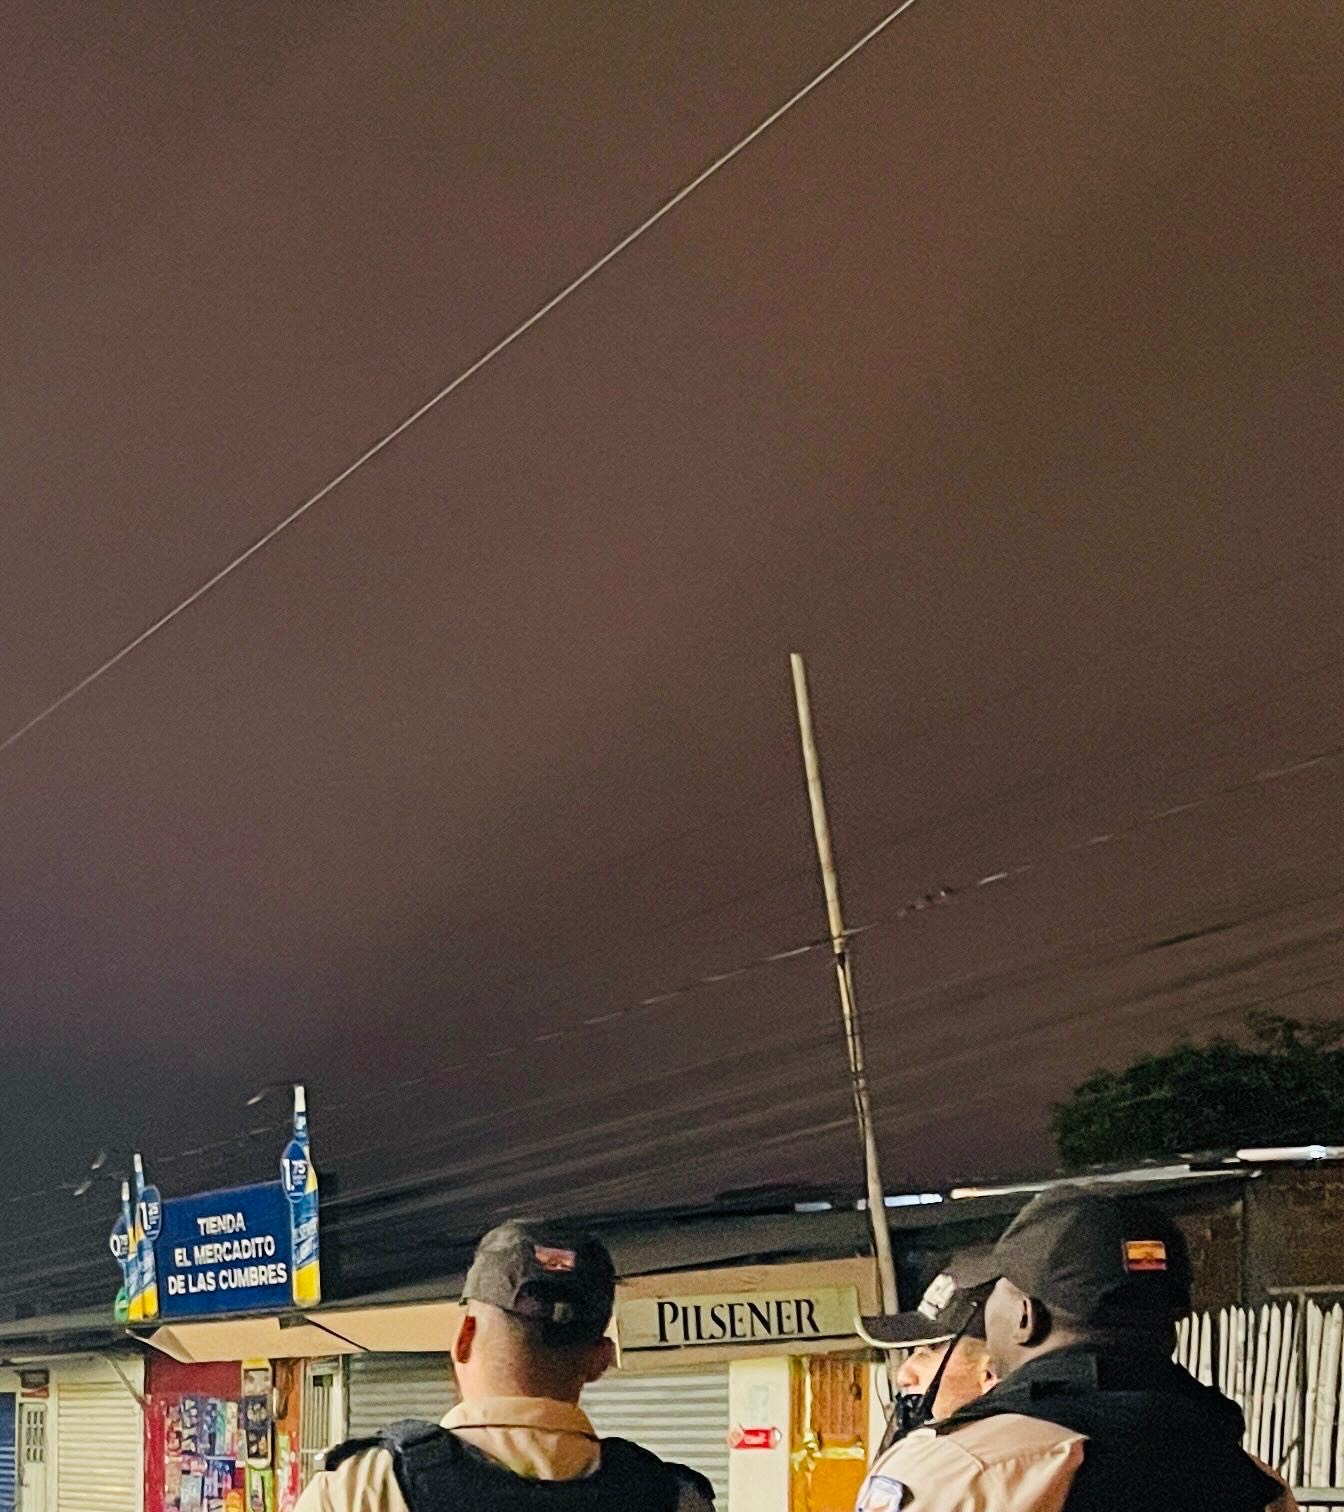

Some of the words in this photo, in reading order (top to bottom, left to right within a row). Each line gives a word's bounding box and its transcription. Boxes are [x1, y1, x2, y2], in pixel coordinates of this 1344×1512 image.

[196, 1212, 247, 1236] TIENDA
[174, 1247, 192, 1268] EL
[193, 1235, 276, 1266] MERCADITO
[167, 1274, 186, 1295] DE
[188, 1271, 217, 1293] LAS
[218, 1262, 288, 1290] CUMBRES
